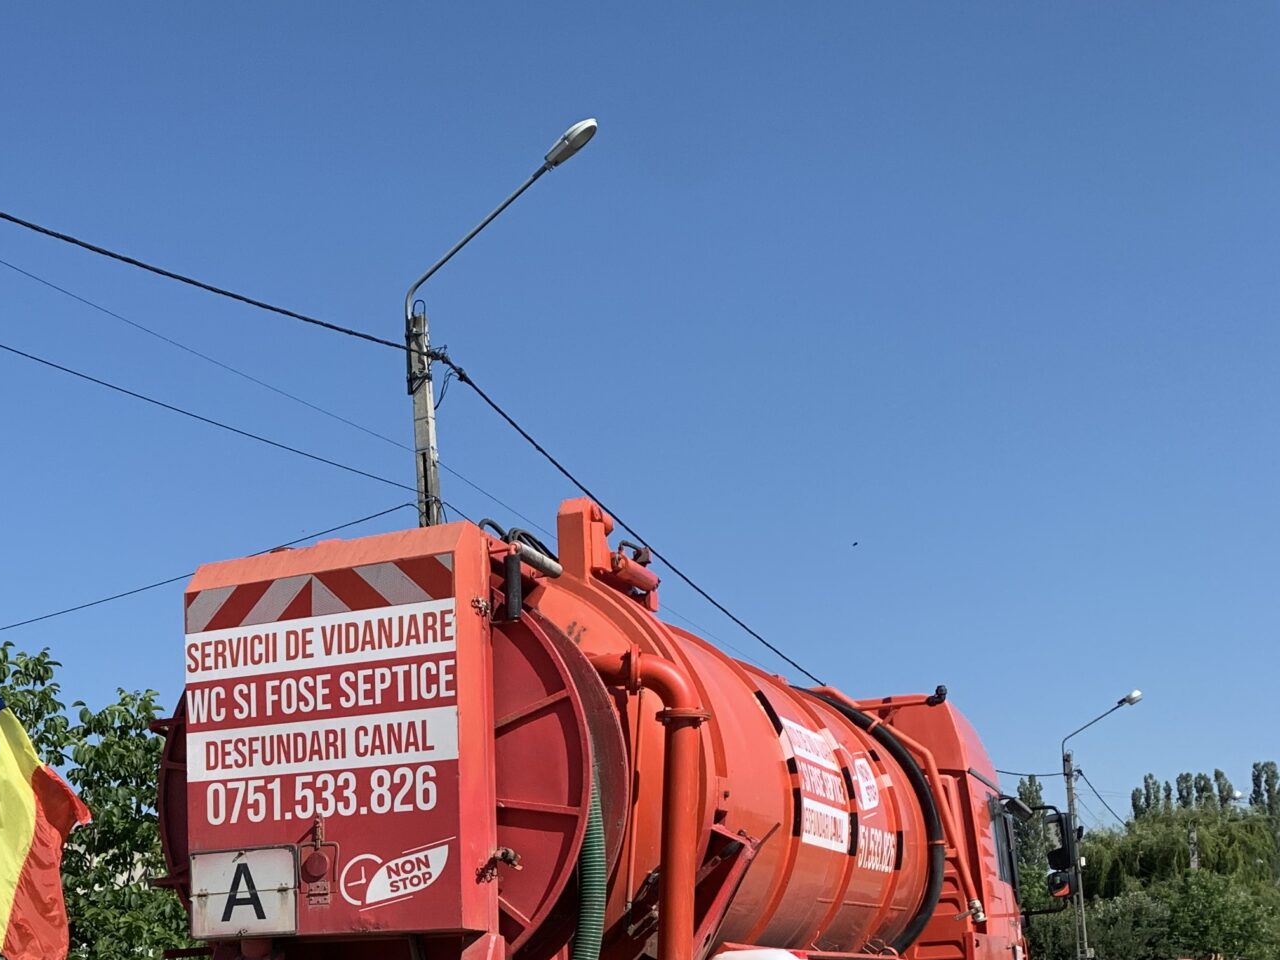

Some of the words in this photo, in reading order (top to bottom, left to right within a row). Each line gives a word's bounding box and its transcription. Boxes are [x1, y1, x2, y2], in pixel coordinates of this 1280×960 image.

[186, 631, 278, 674] SERVICII
[285, 627, 314, 662] DE
[321, 608, 455, 656] VIDANJARE
[187, 686, 226, 725] WC
[233, 682, 257, 720] SI
[266, 674, 331, 716] FOSE
[339, 659, 456, 708] SEPTICE
[205, 727, 347, 771] DESFUNDARI
[355, 719, 435, 759] CANAL
[206, 764, 437, 826] 0751.533.826
[221, 862, 267, 922] A
[386, 854, 431, 879] NON
[389, 871, 433, 893] STOP
